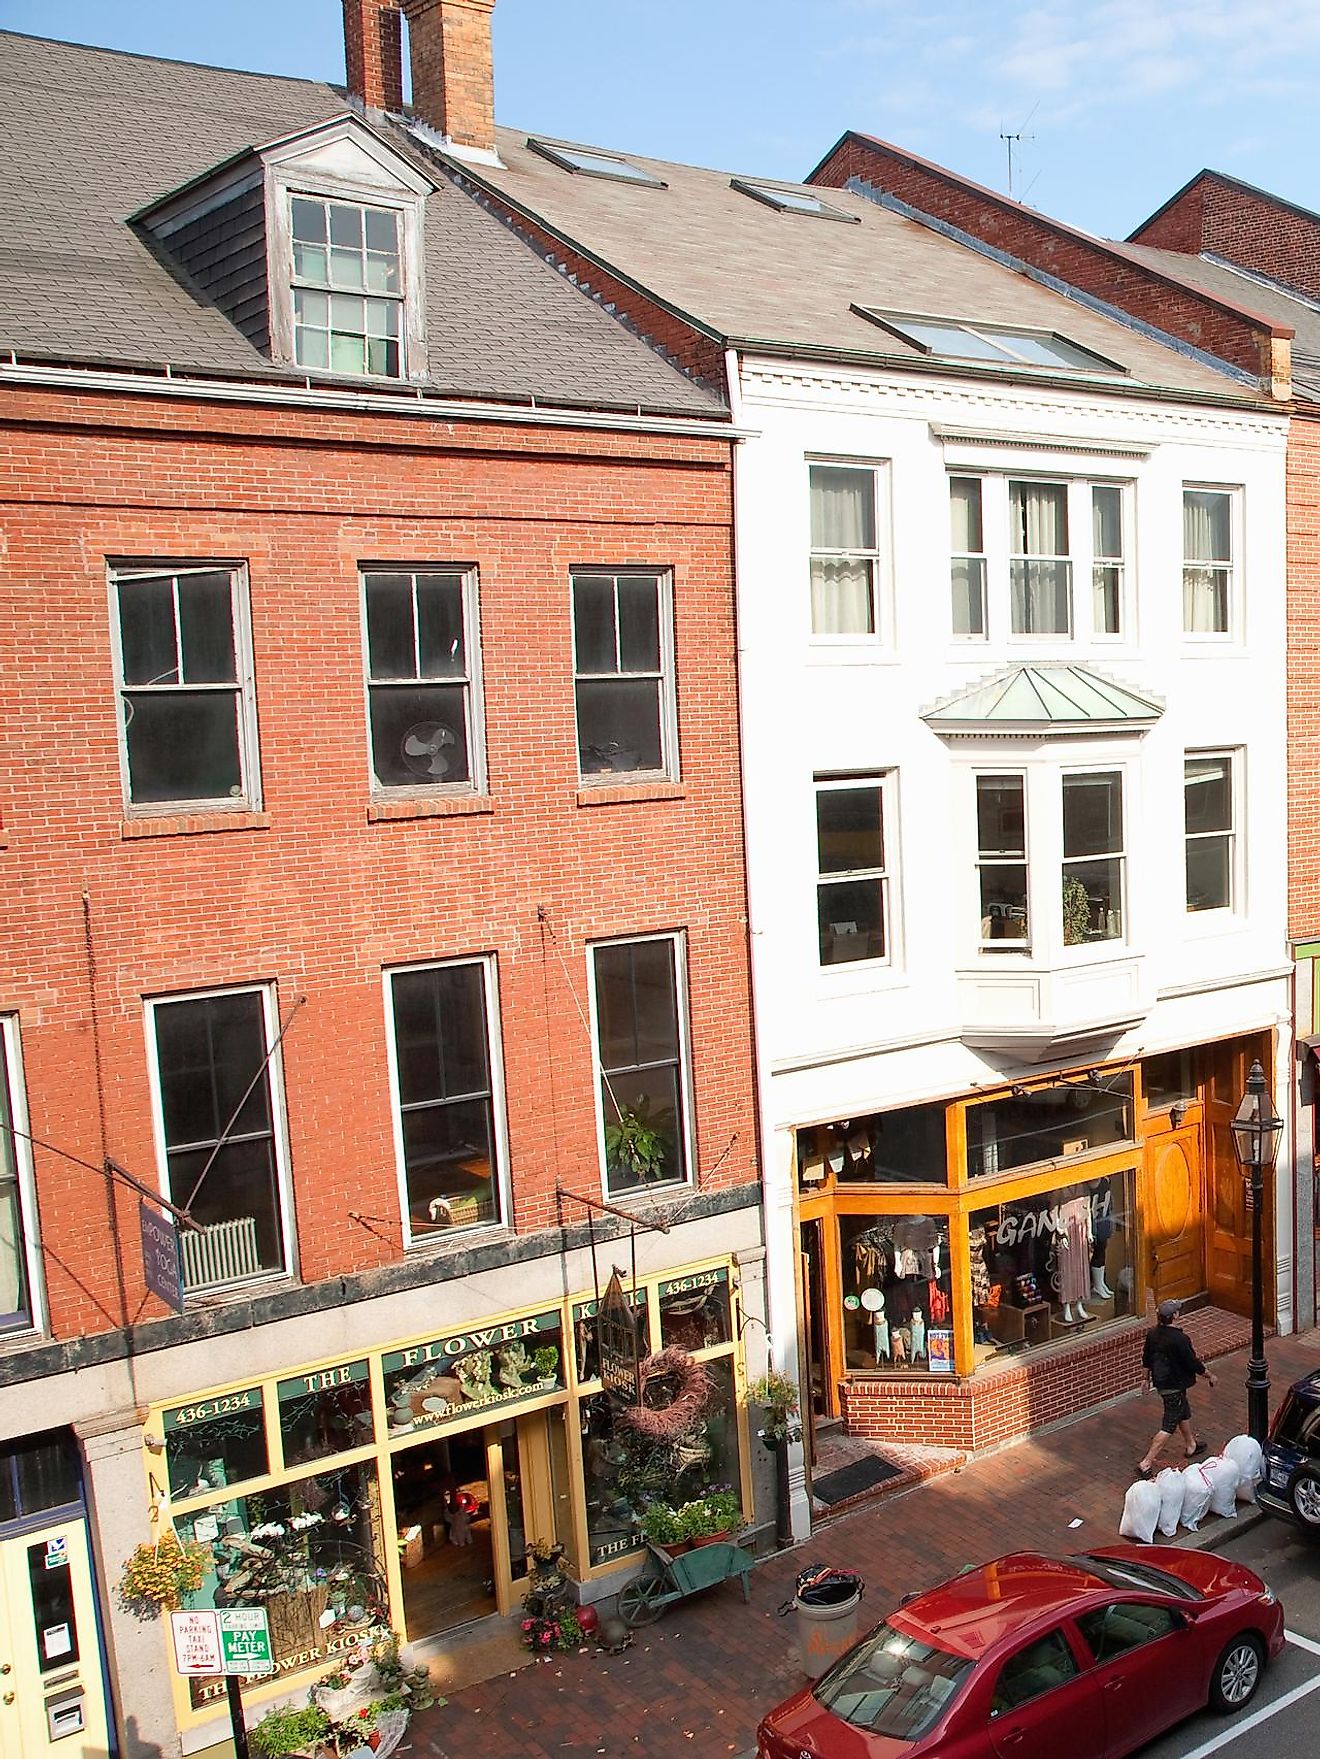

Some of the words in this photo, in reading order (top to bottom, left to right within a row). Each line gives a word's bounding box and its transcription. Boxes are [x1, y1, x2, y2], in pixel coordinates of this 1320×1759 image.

[996, 1190, 1111, 1246] GANH
[175, 1393, 251, 1426] 436-1234
[303, 1366, 352, 1394] THE
[402, 1317, 542, 1368] FLOWER
[665, 1271, 720, 1296] 436-1234
[602, 1358, 635, 1385] FLOWER
[602, 1370, 637, 1397] KIOSK
[412, 1381, 545, 1427] www.flowerkiosk.com
[597, 1538, 628, 1557] THE
[189, 1616, 199, 1625] NO
[222, 1611, 232, 1624] 2
[235, 1612, 260, 1621] HOUR
[180, 1625, 212, 1634] PARKING
[233, 1631, 257, 1642] PAY
[188, 1634, 205, 1643] TAXI
[186, 1644, 209, 1653] STAND
[228, 1641, 266, 1653] METER
[247, 1647, 322, 1685] OWER
